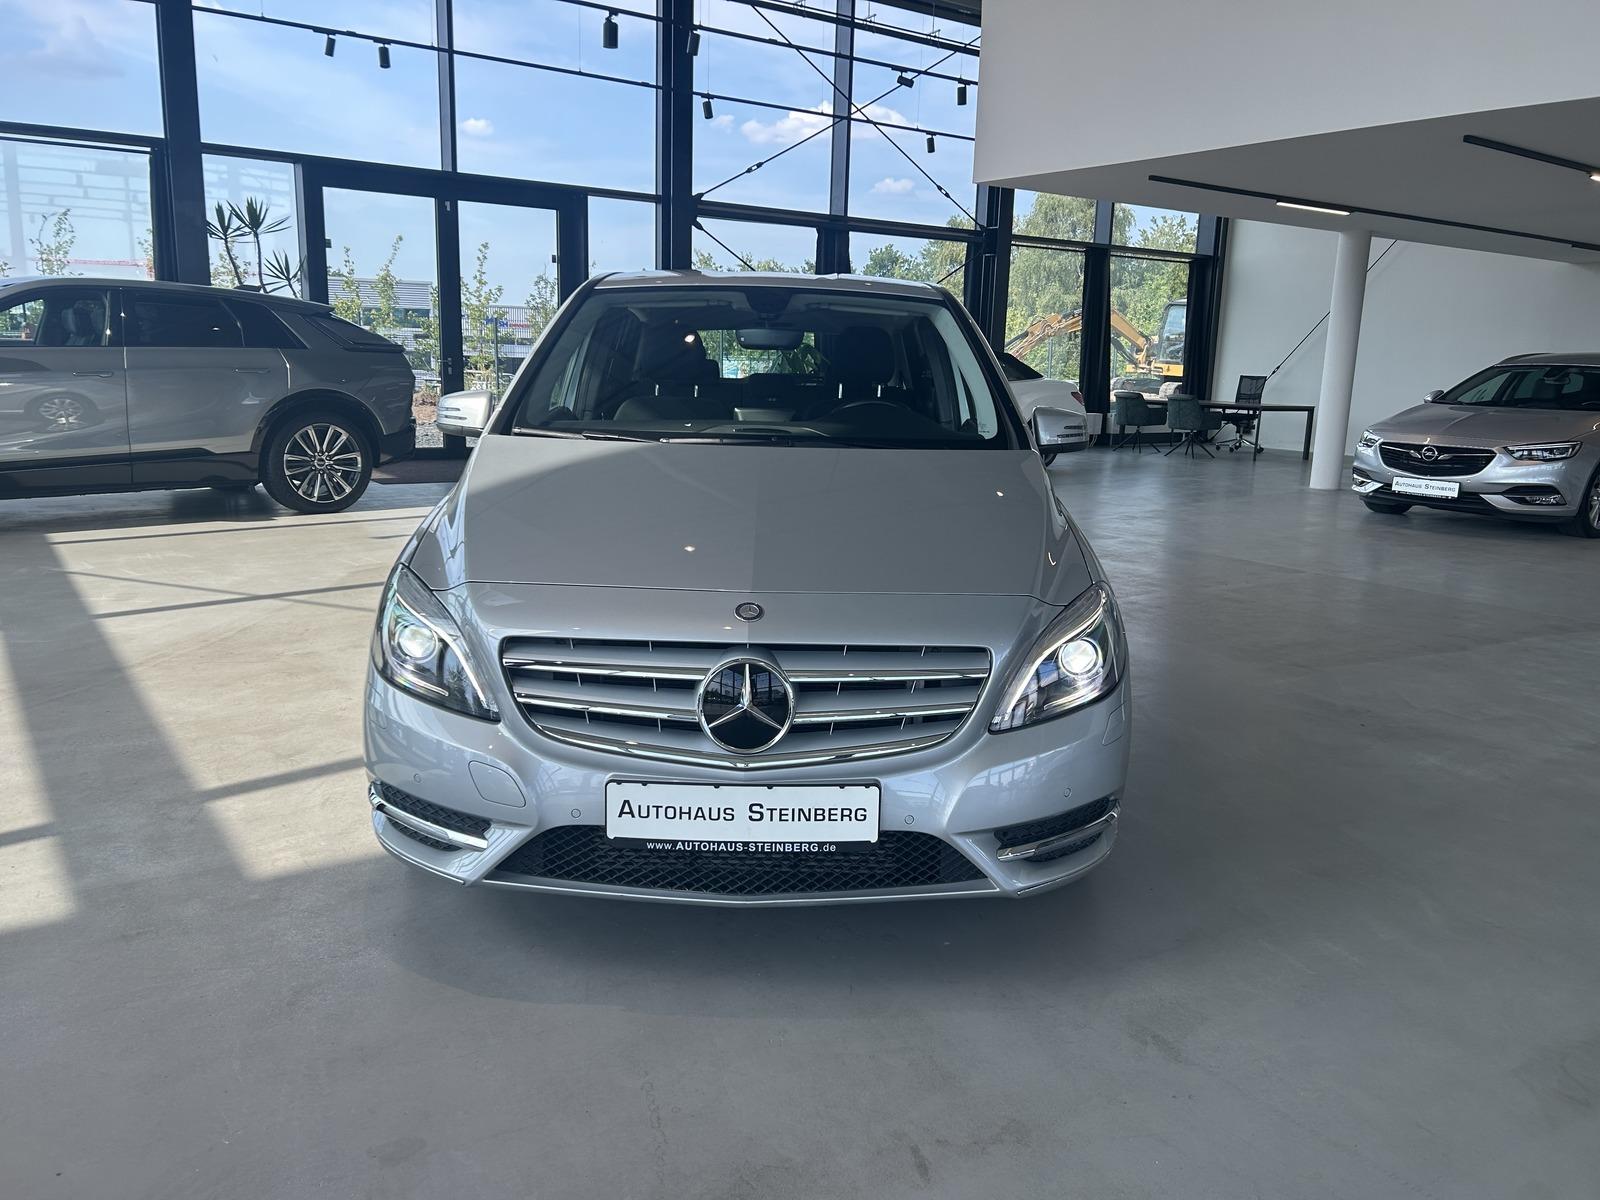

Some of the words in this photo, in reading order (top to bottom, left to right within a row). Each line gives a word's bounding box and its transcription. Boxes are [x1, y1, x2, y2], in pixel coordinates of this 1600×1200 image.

[1424, 484, 1456, 492] STEINBERG
[617, 799, 735, 822] AUTOHAUS
[748, 802, 868, 823] STEINBERG
[646, 841, 837, 852] www.AUTOHAUS-STEINBERG.de
